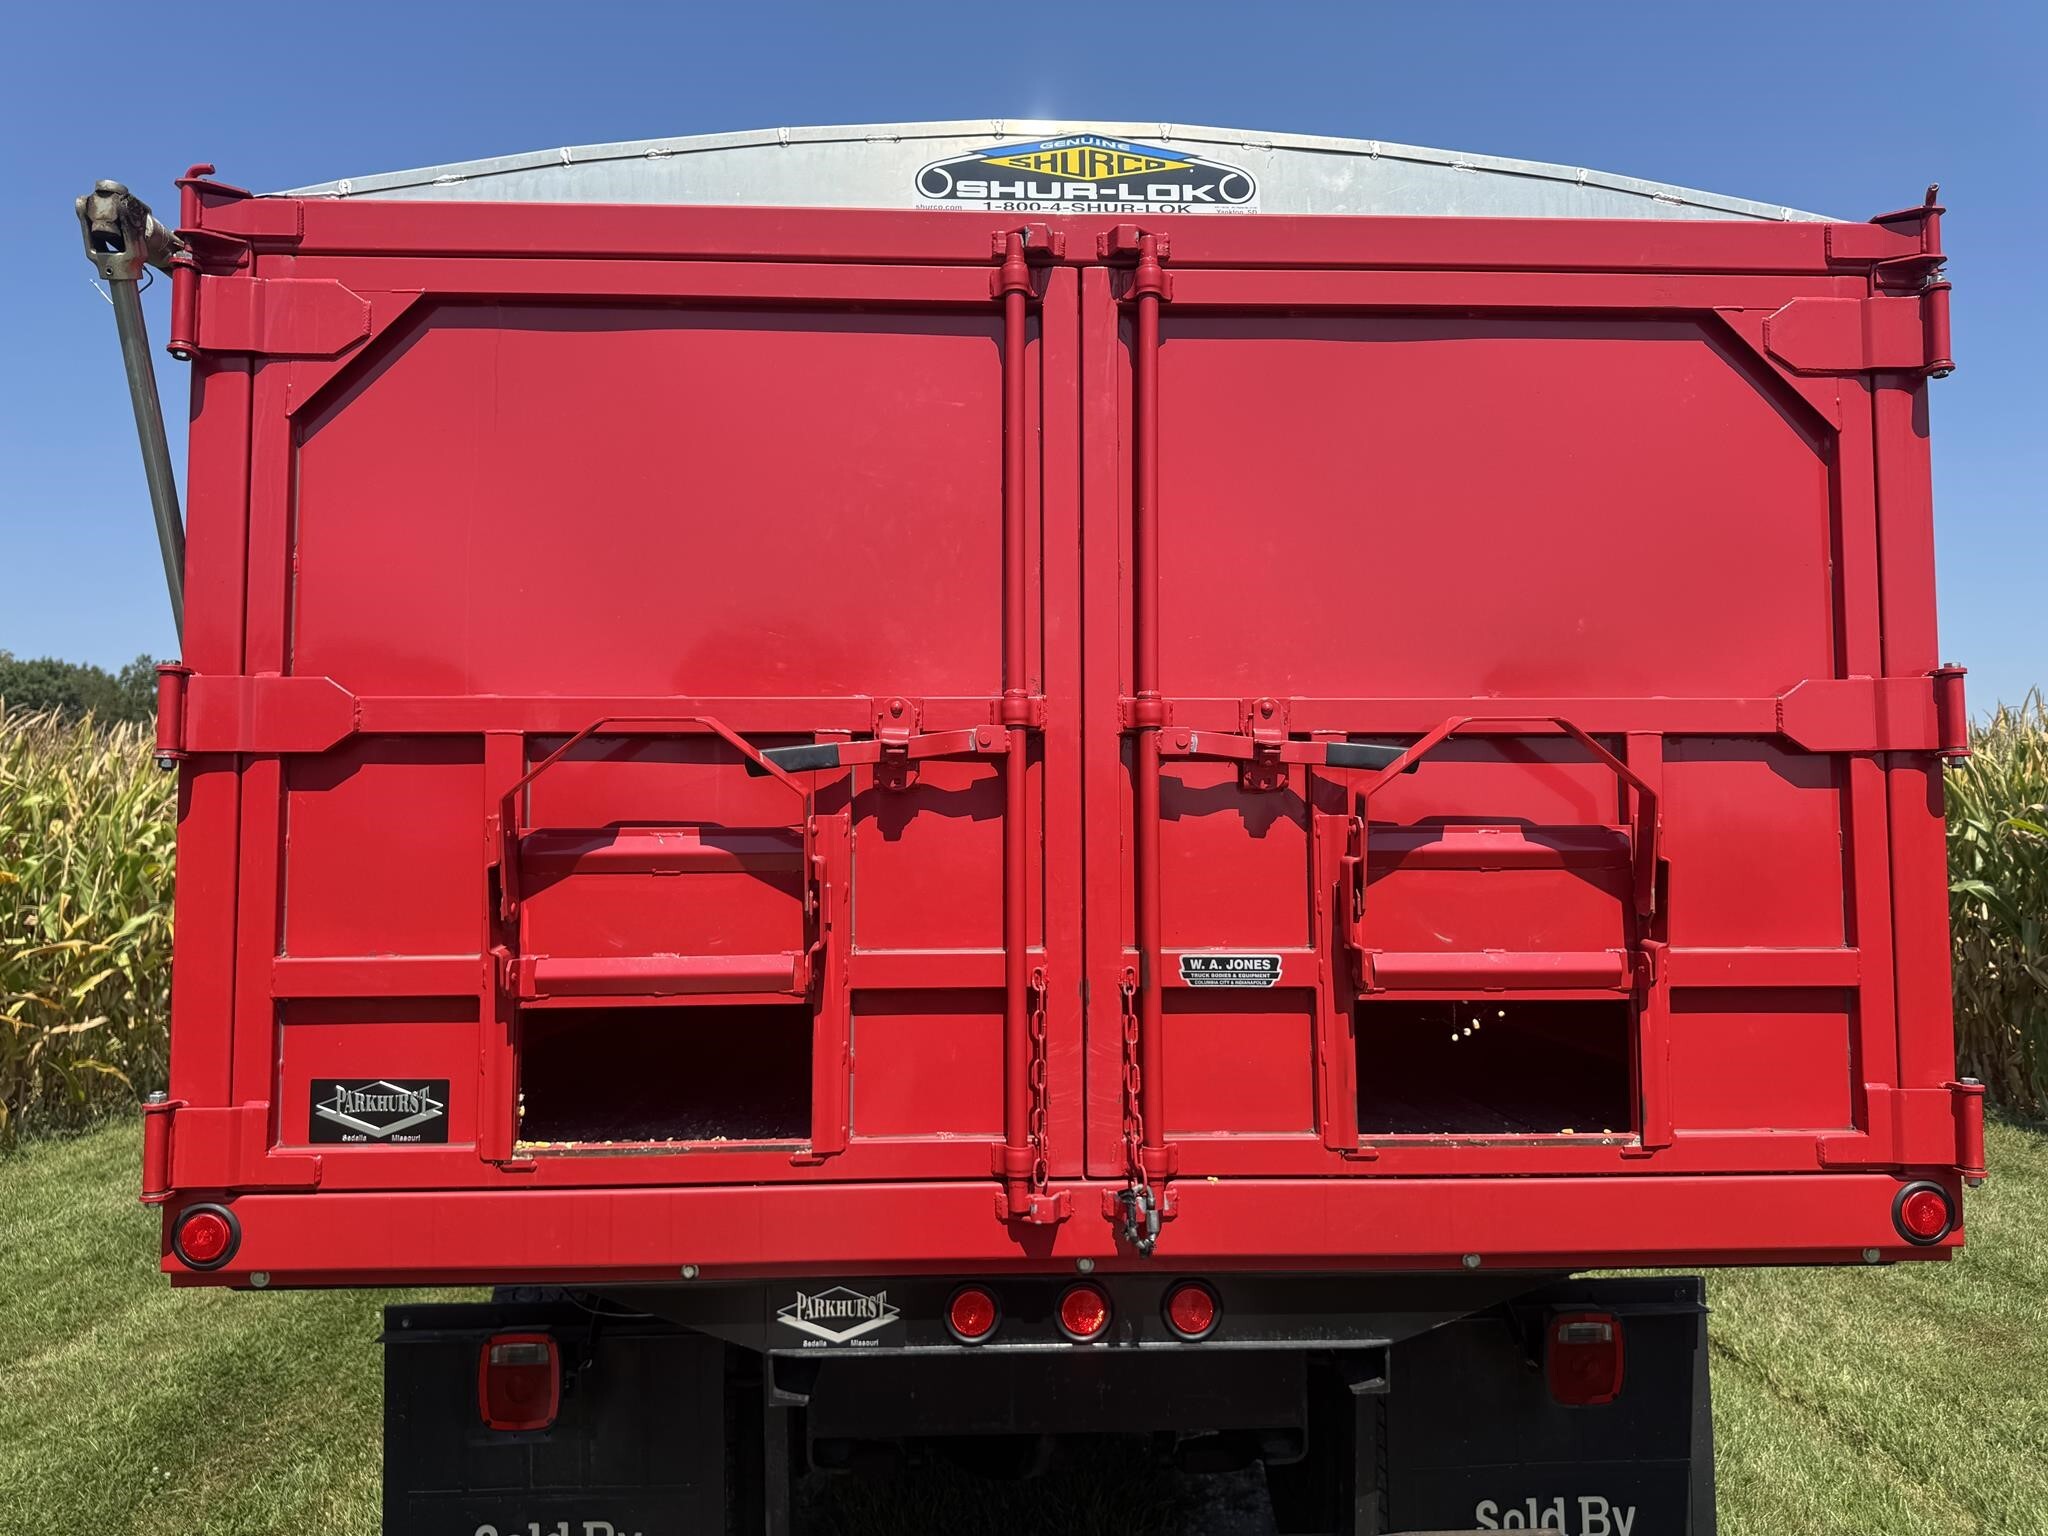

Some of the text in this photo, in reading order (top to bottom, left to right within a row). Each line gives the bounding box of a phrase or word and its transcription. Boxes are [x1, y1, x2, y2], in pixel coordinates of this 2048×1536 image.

[1039, 137, 1130, 151] GENUINE
[1008, 149, 1166, 178] SHURCO
[955, 180, 1215, 202] SHUR-LOK
[915, 203, 963, 211] shurco.com
[984, 201, 1192, 213] 1-800-4-SHUR-LOK
[1189, 959, 1271, 970] W. A. JONES
[335, 1085, 430, 1116] PARKHURST
[341, 1134, 421, 1142] Sedalia Missouri
[796, 1290, 887, 1321] PARKHURST
[802, 1339, 879, 1347] Sedalia Missouri
[1475, 1496, 1636, 1536] Sold By
